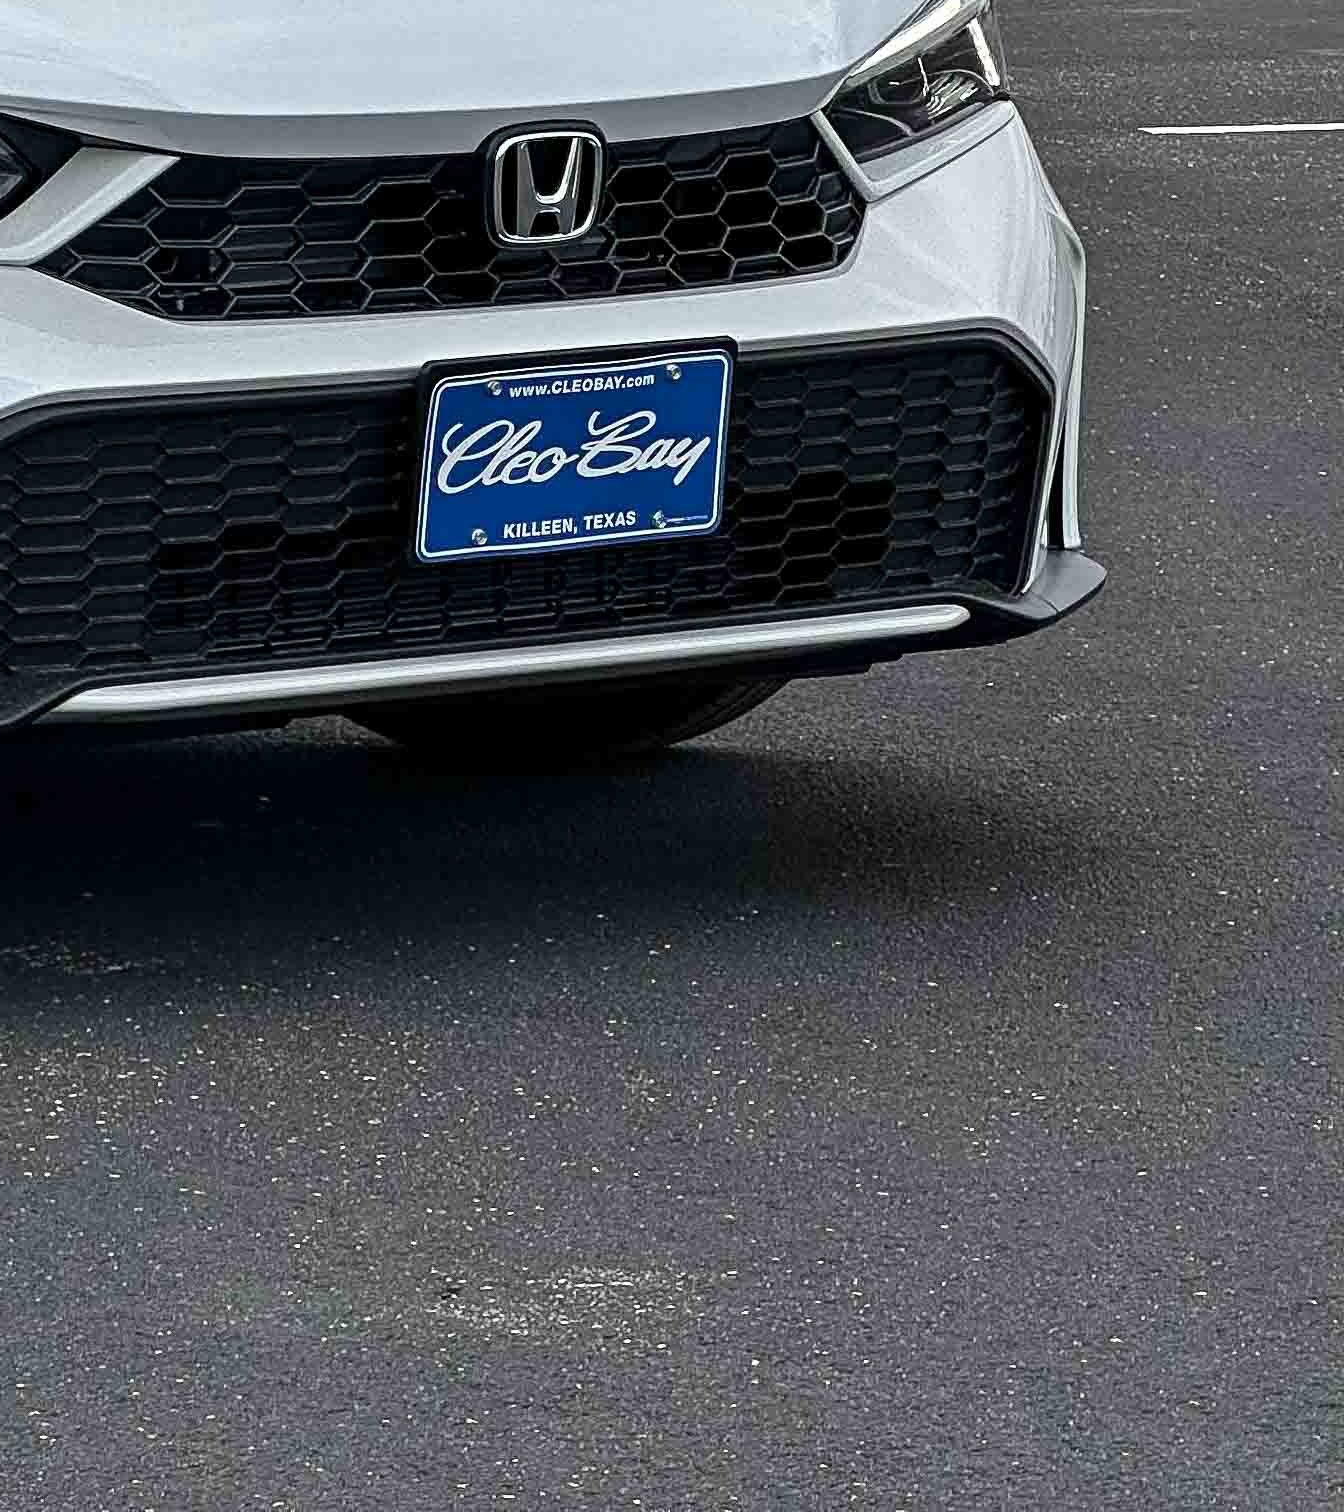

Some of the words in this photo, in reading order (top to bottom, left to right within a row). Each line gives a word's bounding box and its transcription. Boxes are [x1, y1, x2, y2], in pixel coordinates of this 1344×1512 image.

[508, 374, 655, 399] www.CLEOBAY.com
[437, 419, 580, 495] Cleo
[575, 410, 712, 486] Bay
[502, 517, 578, 540] KILLEEN,
[583, 510, 637, 531] TEXAS
